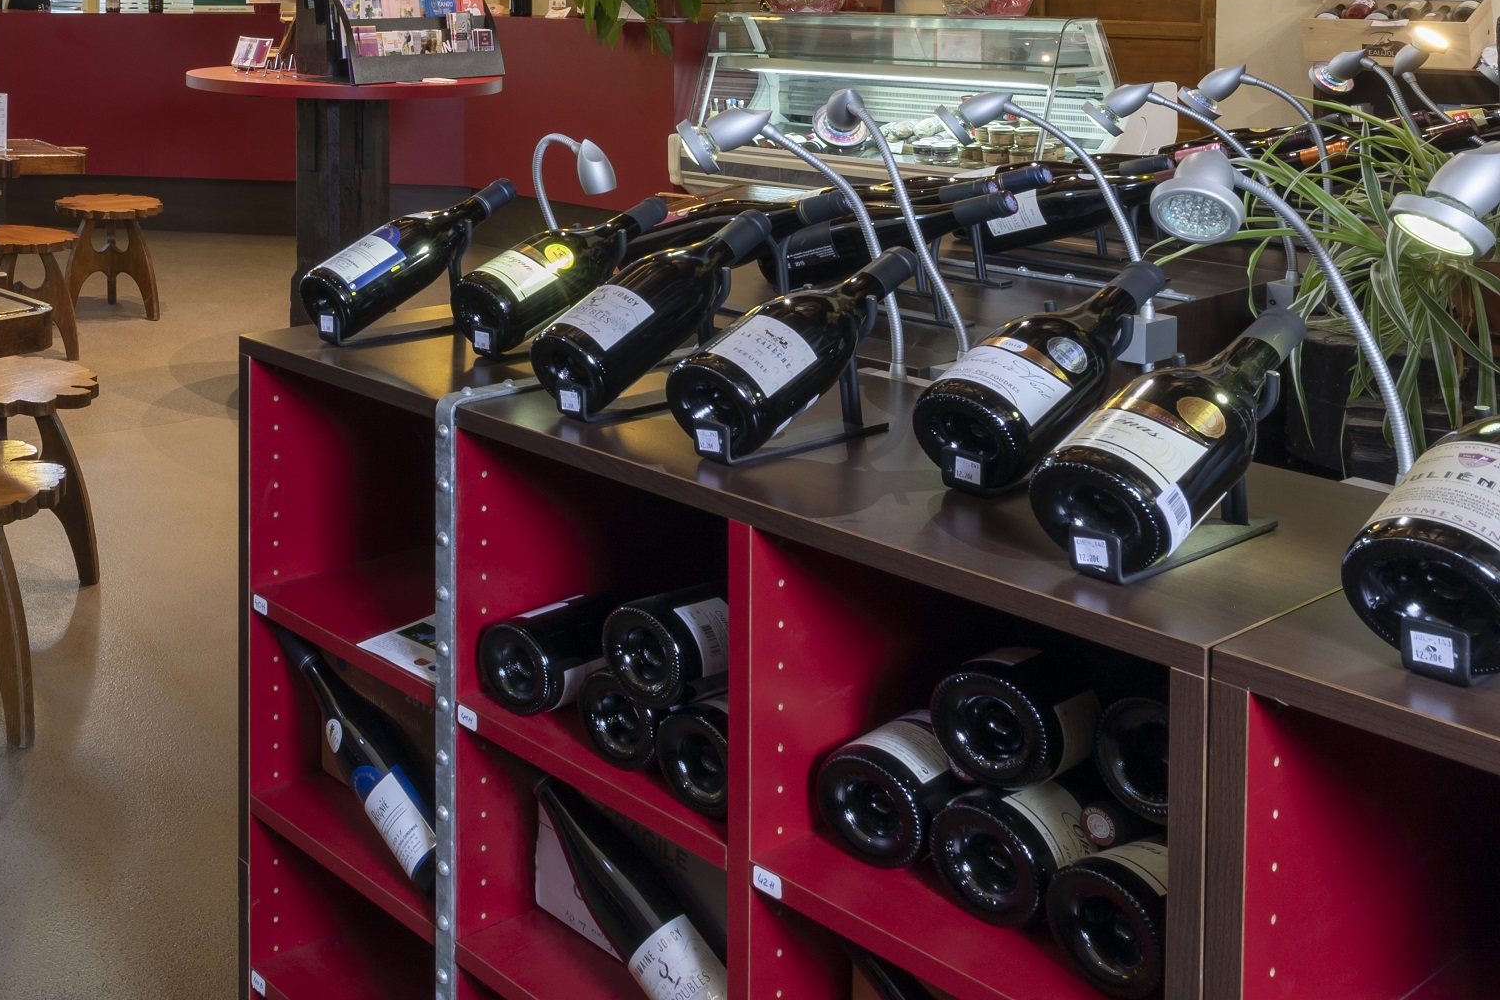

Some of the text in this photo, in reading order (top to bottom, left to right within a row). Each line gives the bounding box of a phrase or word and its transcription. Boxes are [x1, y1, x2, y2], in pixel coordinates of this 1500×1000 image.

[612, 289, 639, 307] JONCY
[574, 305, 611, 324] OUBLES
[1004, 341, 1022, 349] 2016
[990, 373, 1021, 394] FOUDRES
[1397, 471, 1500, 493] JULIÉN
[1379, 507, 1500, 541] MOMMESSIN
[1078, 553, 1100, 563] 12.20€
[1415, 649, 1442, 663] 12.20€
[657, 927, 683, 952] JONCY
